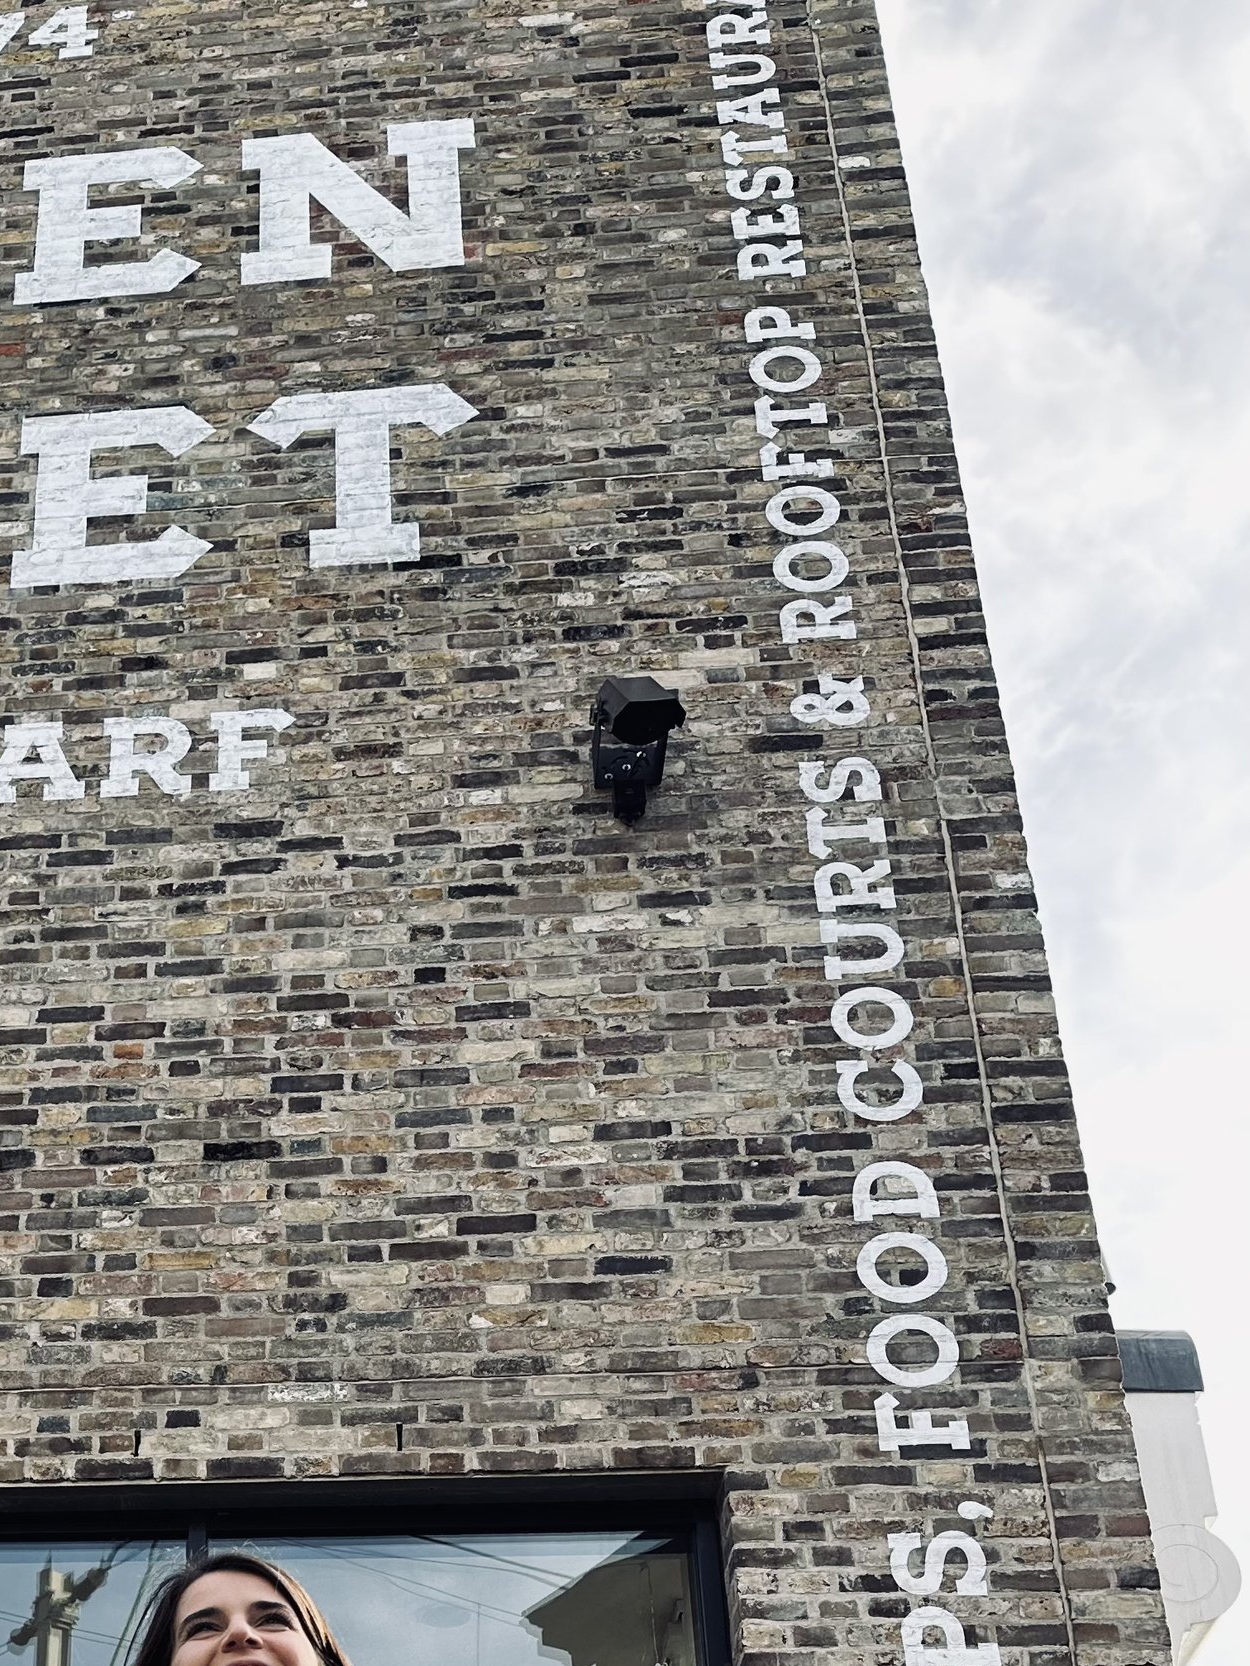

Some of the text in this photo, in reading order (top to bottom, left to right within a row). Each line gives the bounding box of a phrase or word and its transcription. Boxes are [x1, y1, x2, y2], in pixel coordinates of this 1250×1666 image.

[706, 0, 808, 281] RESTAUR
[744, 306, 858, 645] ROOFTOP
[790, 673, 872, 727] &
[798, 756, 923, 1122] COURTS
[852, 1160, 972, 1453] FOOD
